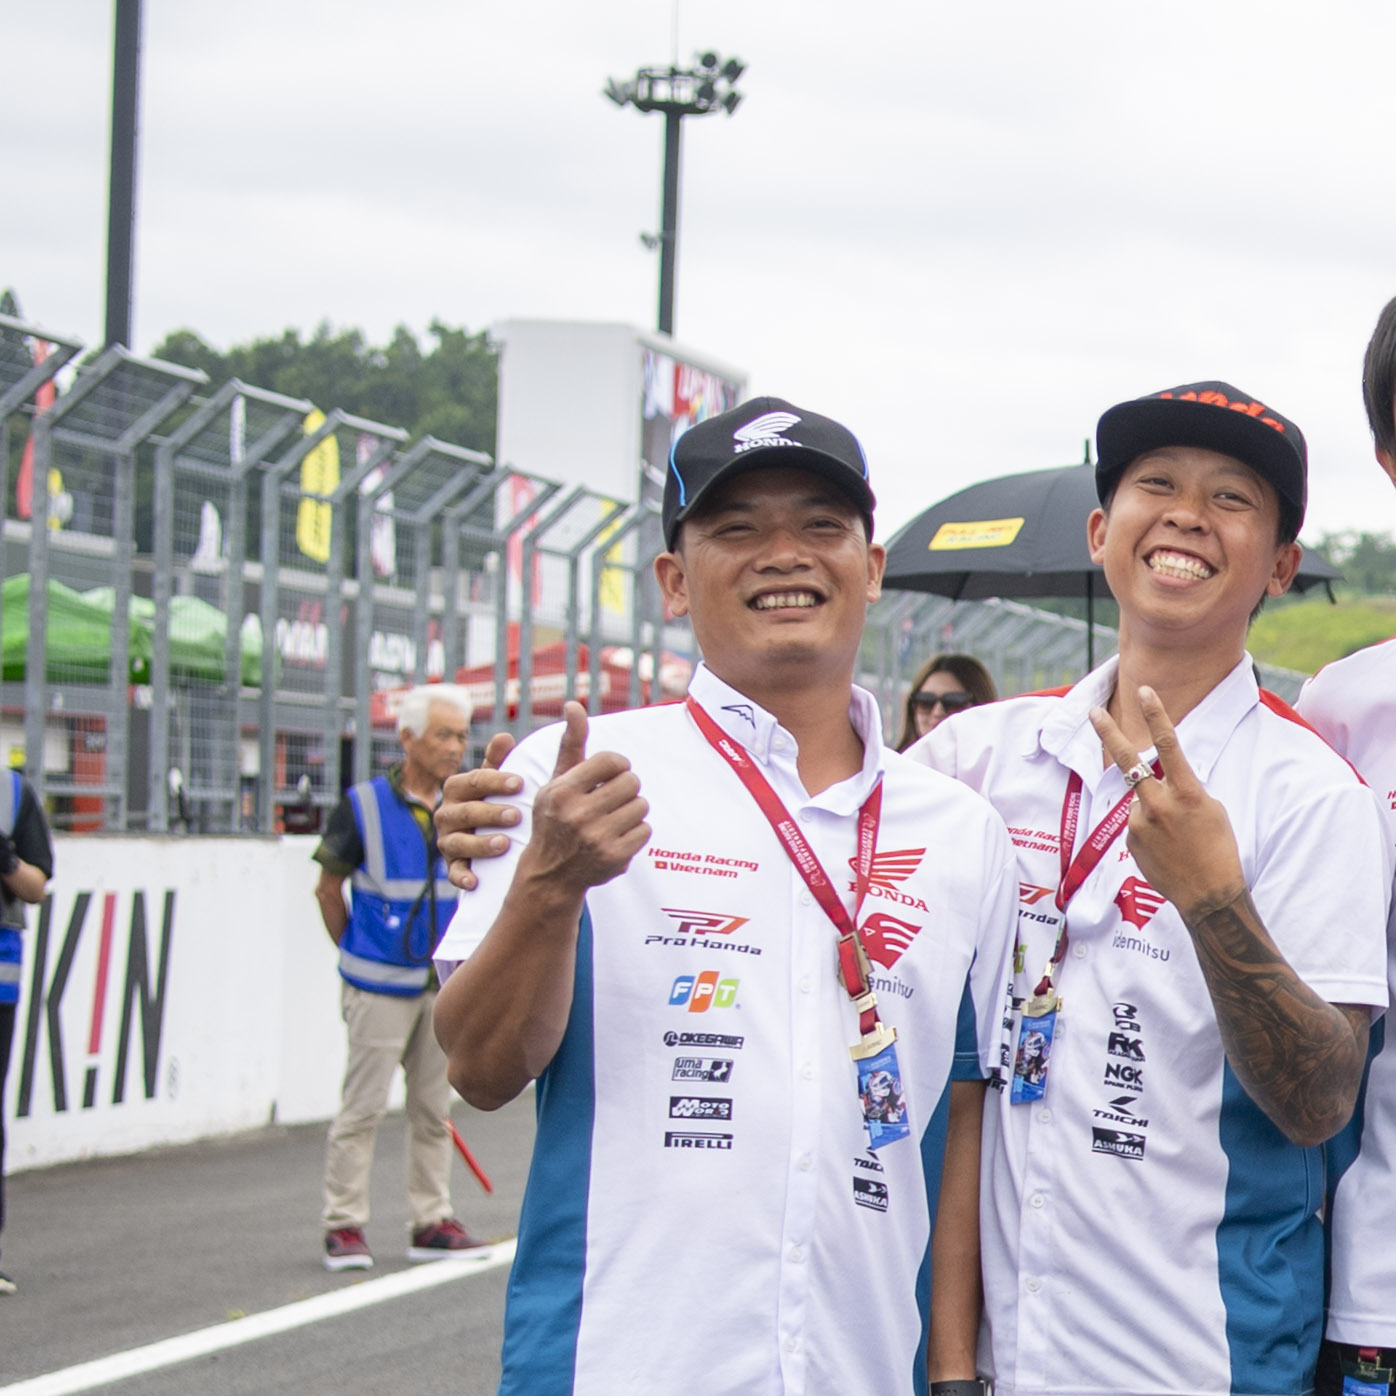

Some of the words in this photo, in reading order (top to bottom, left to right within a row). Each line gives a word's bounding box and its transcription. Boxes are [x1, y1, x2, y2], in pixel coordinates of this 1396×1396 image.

[733, 438, 803, 454] HOND
[648, 848, 702, 861] Honda
[704, 854, 760, 872] Racing
[669, 862, 738, 878] Vietnam
[645, 935, 687, 946] Pro
[690, 937, 762, 956] Honda
[1112, 929, 1171, 963] idemitsu
[867, 976, 915, 999] emitsu
[675, 1058, 703, 1069] uma
[675, 1069, 709, 1081] racing
[1104, 1062, 1144, 1086] NGK
[1092, 1109, 1150, 1128] TAICHI
[663, 1131, 735, 1150] PIRELLI
